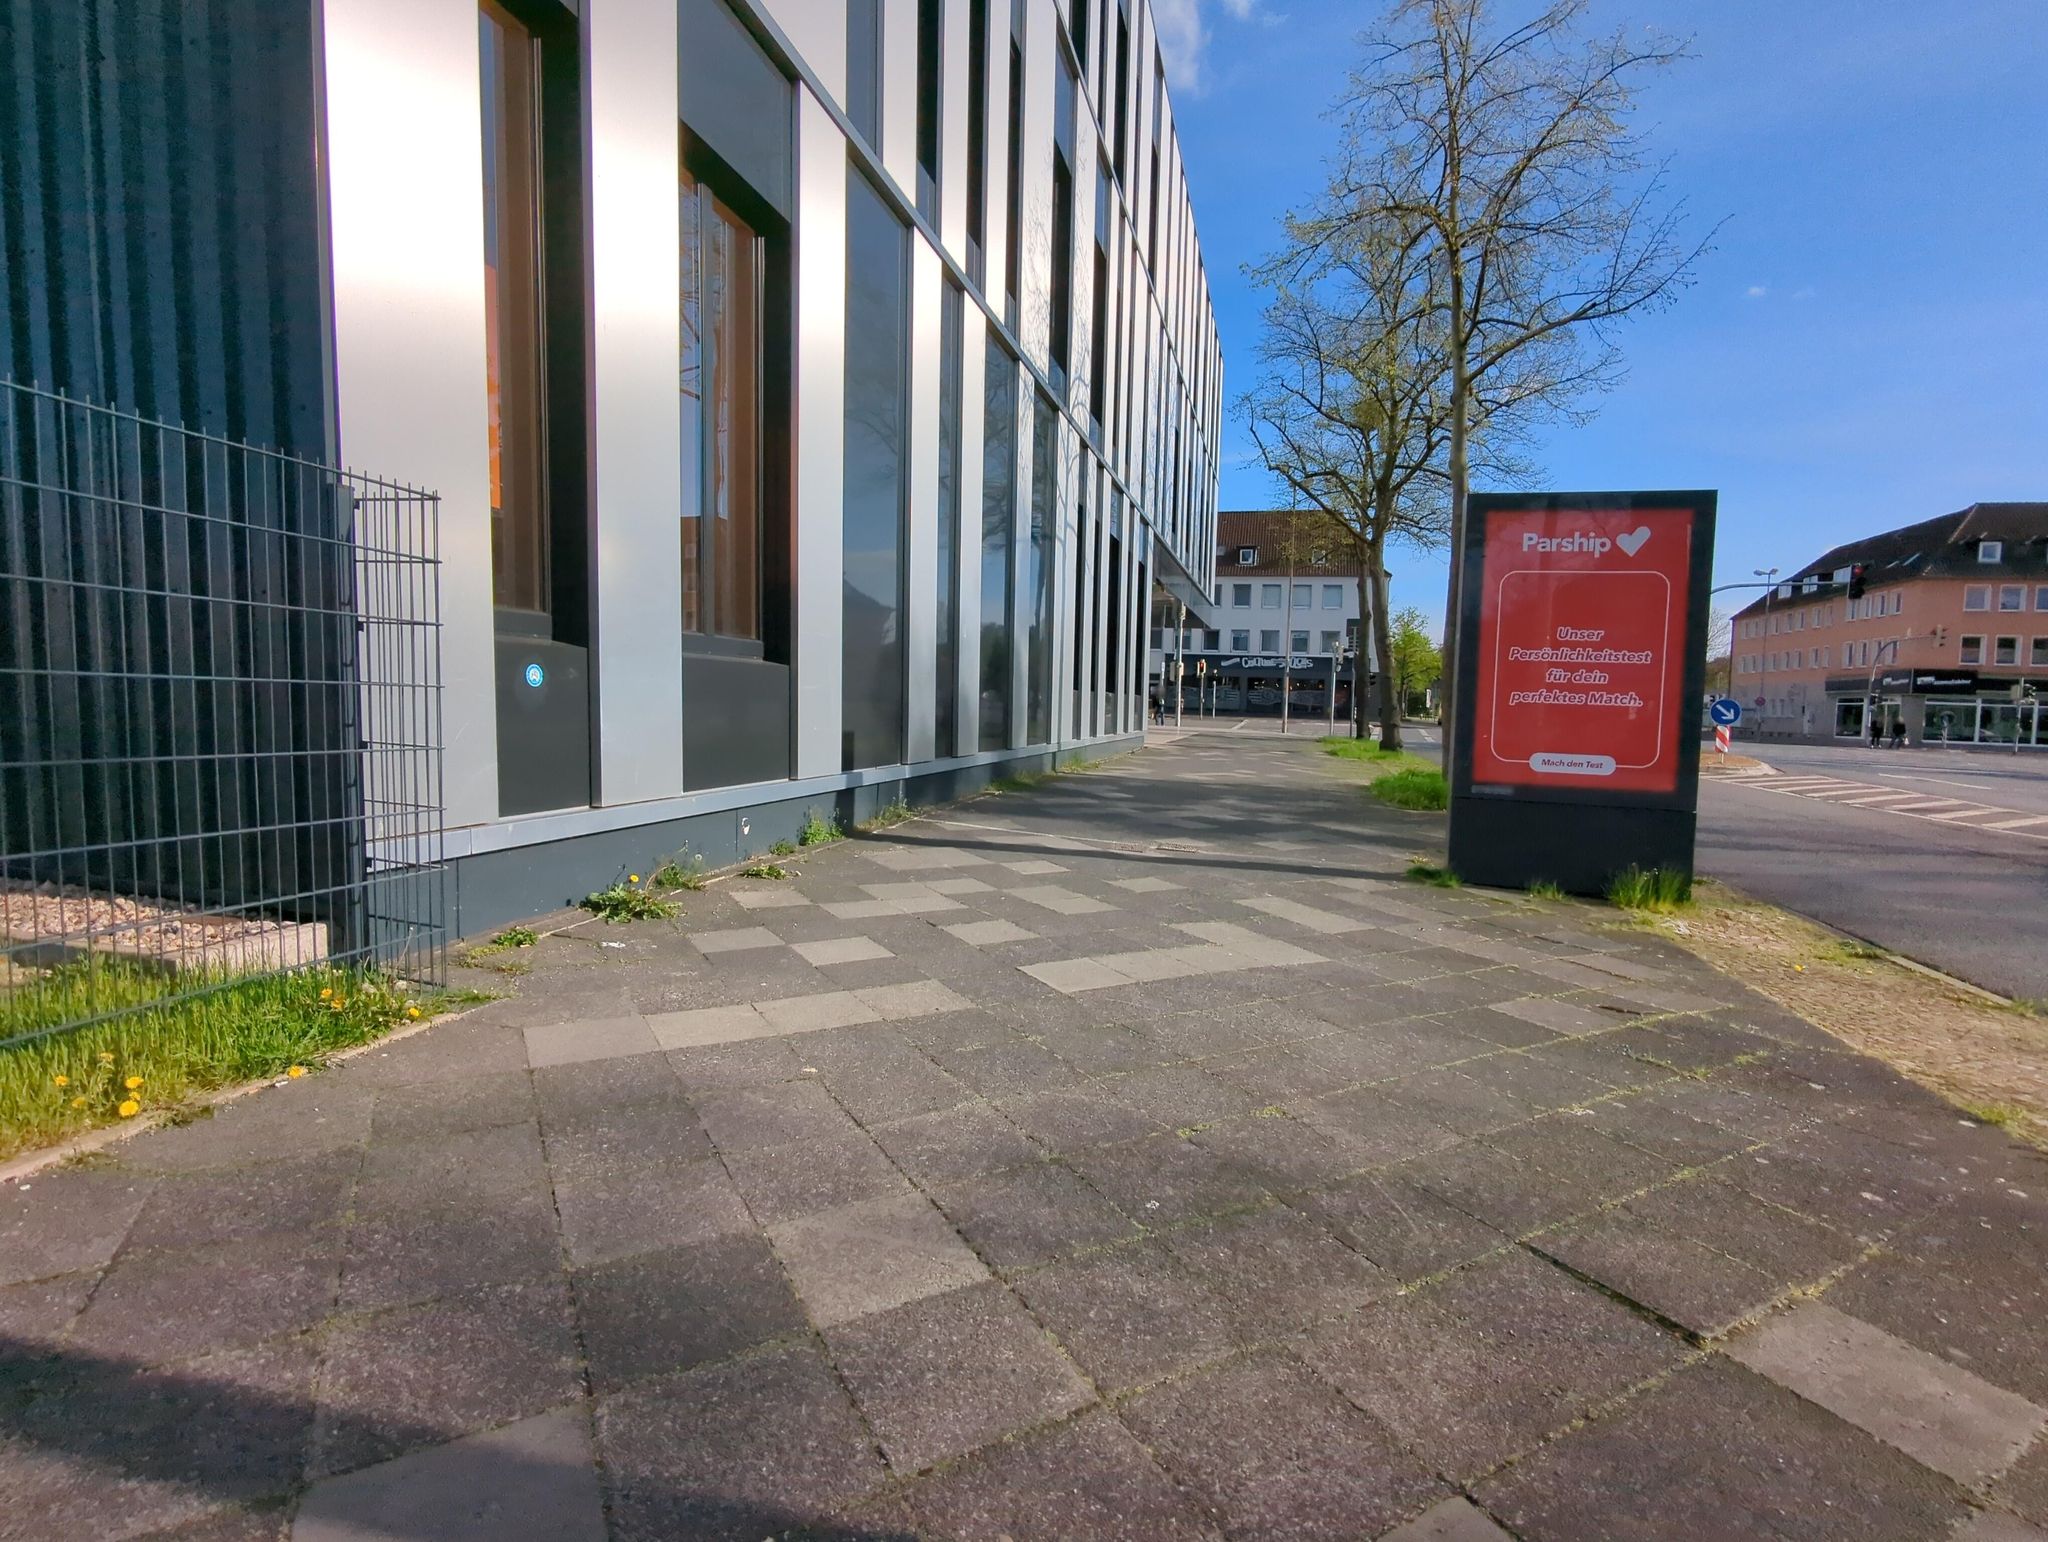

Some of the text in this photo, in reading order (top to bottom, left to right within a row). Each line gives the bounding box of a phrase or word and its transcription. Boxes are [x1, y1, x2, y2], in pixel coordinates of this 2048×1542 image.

[1522, 531, 1612, 558] Parship
[1557, 627, 1604, 641] Unser
[1509, 647, 1652, 663] Persönlichkeitstest
[1546, 668, 1608, 684] für dein
[1509, 689, 1643, 706] perfektes Match.
[1541, 759, 1604, 769] Mach den Test
